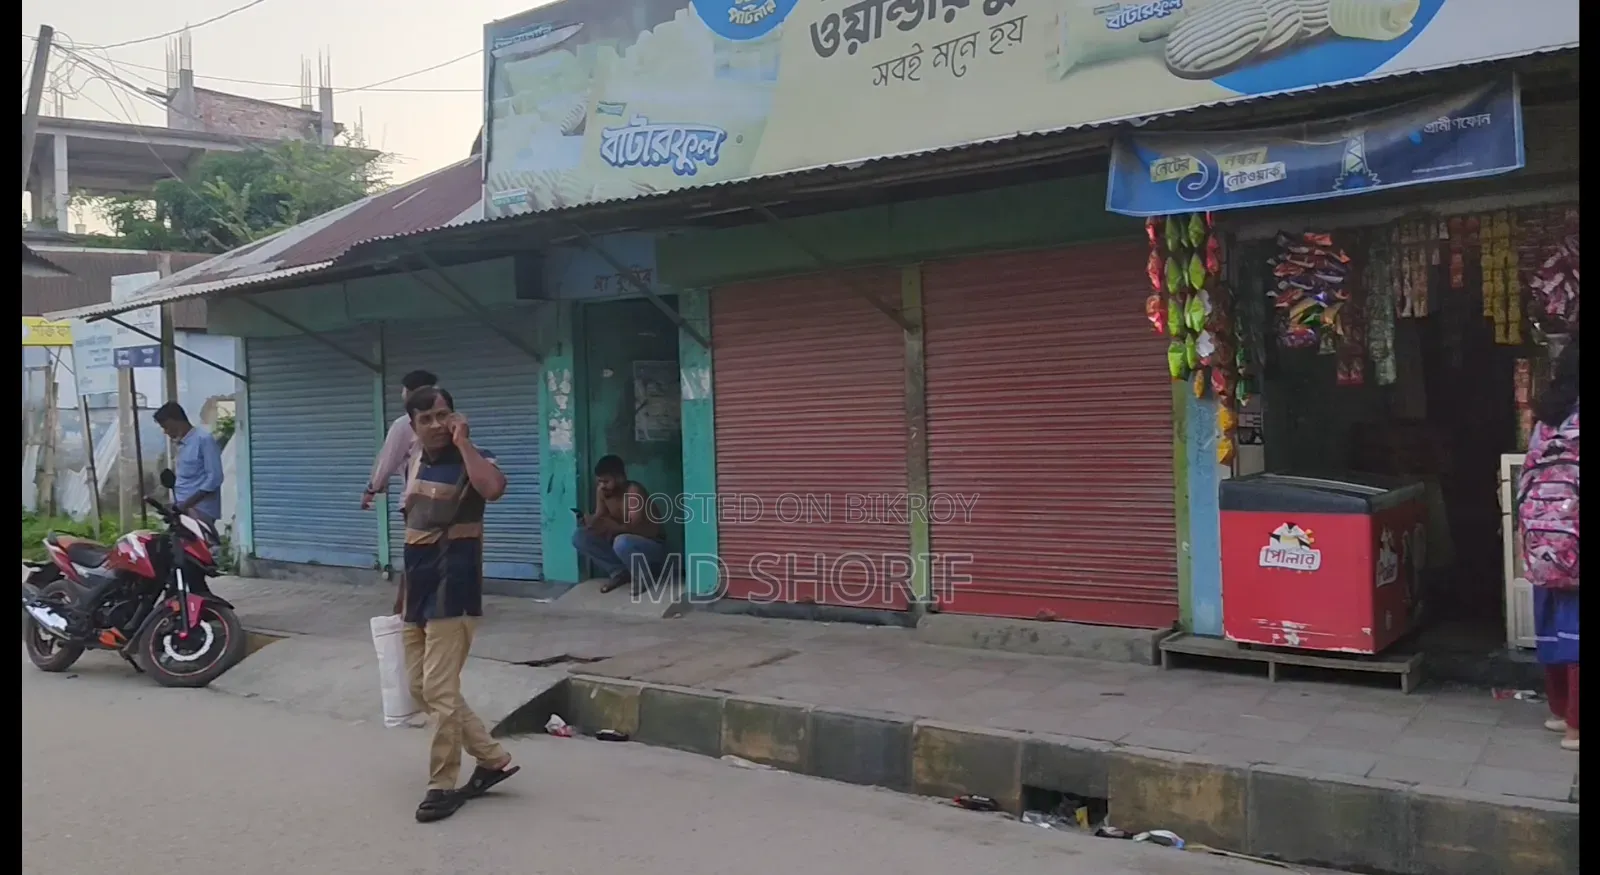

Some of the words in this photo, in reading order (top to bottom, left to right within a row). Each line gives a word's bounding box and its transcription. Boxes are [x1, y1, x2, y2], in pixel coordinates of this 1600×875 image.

[872, 43, 924, 87] সবই
[932, 31, 981, 78] মনে
[989, 15, 1028, 54] হয়
[1424, 113, 1492, 134] গ্রামীণফোন
[600, 114, 728, 176] বাটারফুল
[1155, 157, 1191, 177] নেটের
[1226, 165, 1281, 188] নেটওয়ার্ক
[1264, 548, 1315, 569] পোলার
